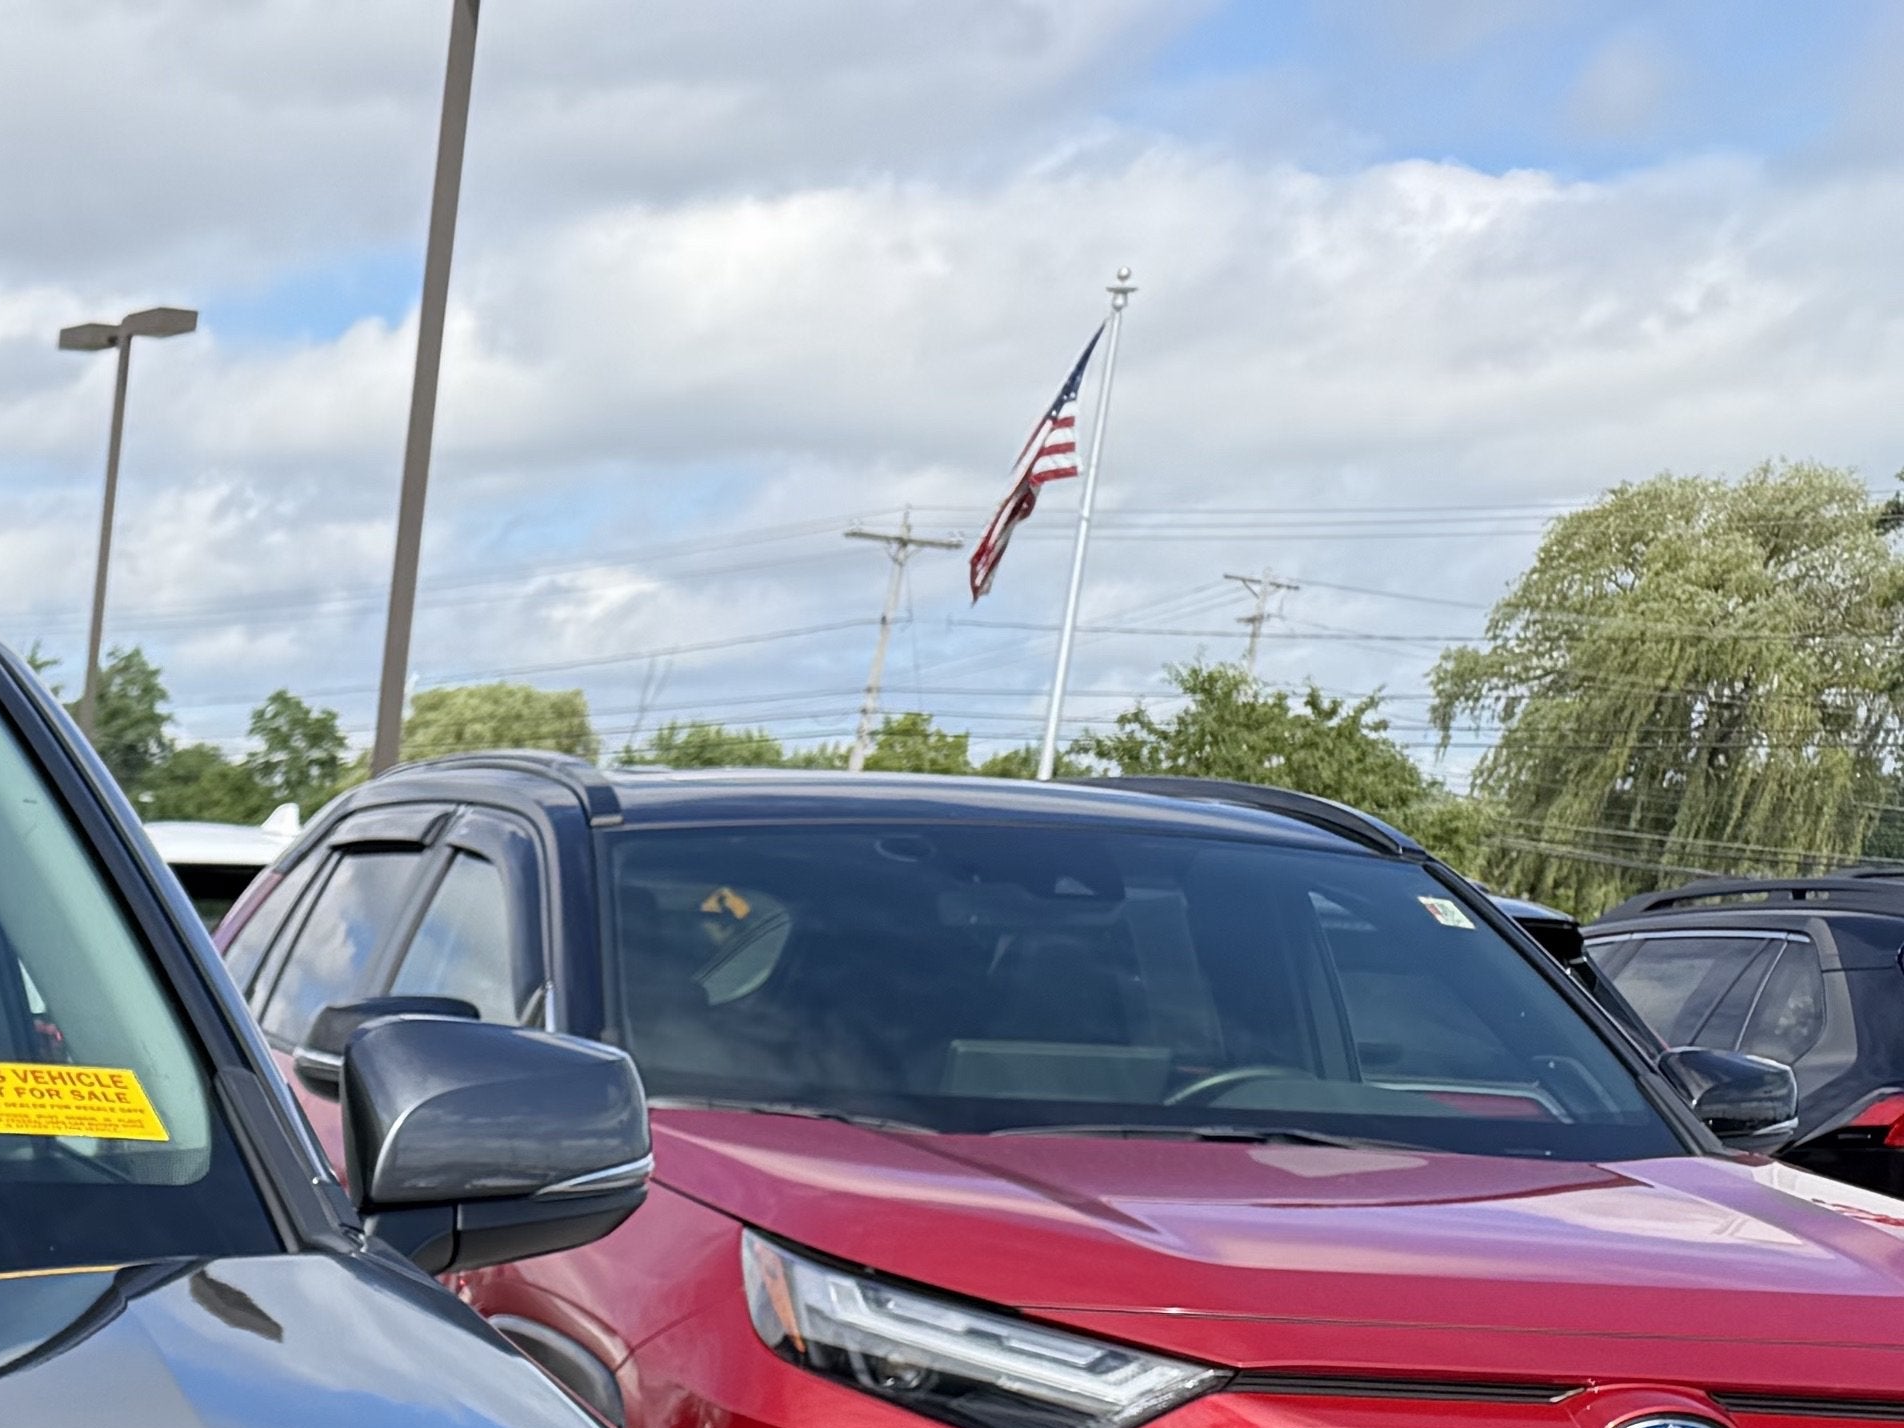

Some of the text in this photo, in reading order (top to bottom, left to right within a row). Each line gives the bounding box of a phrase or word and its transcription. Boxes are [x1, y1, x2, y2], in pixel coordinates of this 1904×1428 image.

[11, 1069, 129, 1090] VEHICLE
[14, 1086, 62, 1100] FOR
[70, 1089, 131, 1104] SALE
